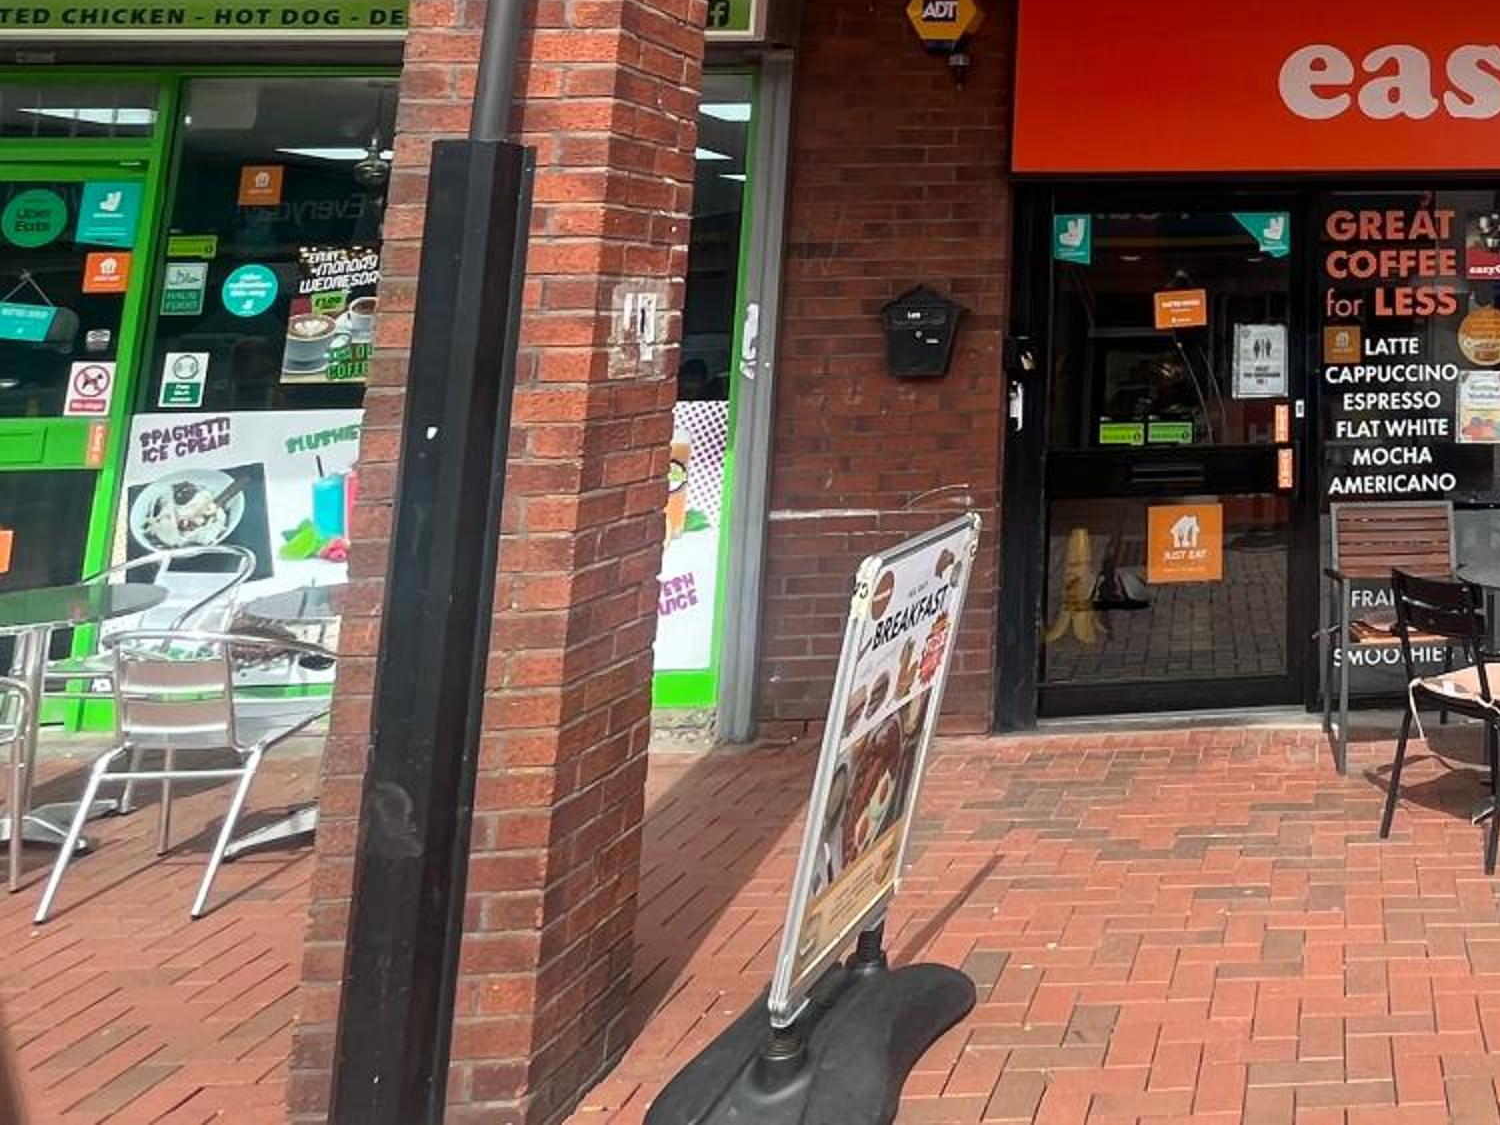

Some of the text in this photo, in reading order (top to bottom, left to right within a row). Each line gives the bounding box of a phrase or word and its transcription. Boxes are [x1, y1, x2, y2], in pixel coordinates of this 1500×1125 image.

[61, 8, 186, 25] CHICKEN
[214, 8, 272, 25] HOT
[280, 8, 341, 26] DOG
[922, 0, 958, 19] ADT
[1326, 209, 1456, 242] GREAT
[316, 254, 379, 276] MONDAY
[1326, 250, 1457, 279] COFFEE
[299, 270, 380, 294] WEDNESDA
[1326, 286, 1457, 317] for LESS
[1365, 337, 1420, 356] LATTE
[1325, 364, 1459, 384] CAPPUCCINO
[1343, 391, 1441, 410] ESPRESSO
[139, 417, 231, 448] SPAGHETTI
[1336, 418, 1449, 438] FLAT WHITE
[141, 434, 231, 463] ICE CREAM
[1352, 446, 1433, 466] MOCHA
[1327, 473, 1457, 494] AMERICANO
[662, 572, 695, 597] ESH
[659, 588, 698, 615] UICE
[871, 583, 950, 652] BREAKFAST
[1333, 644, 1456, 667] SMOOHIE
